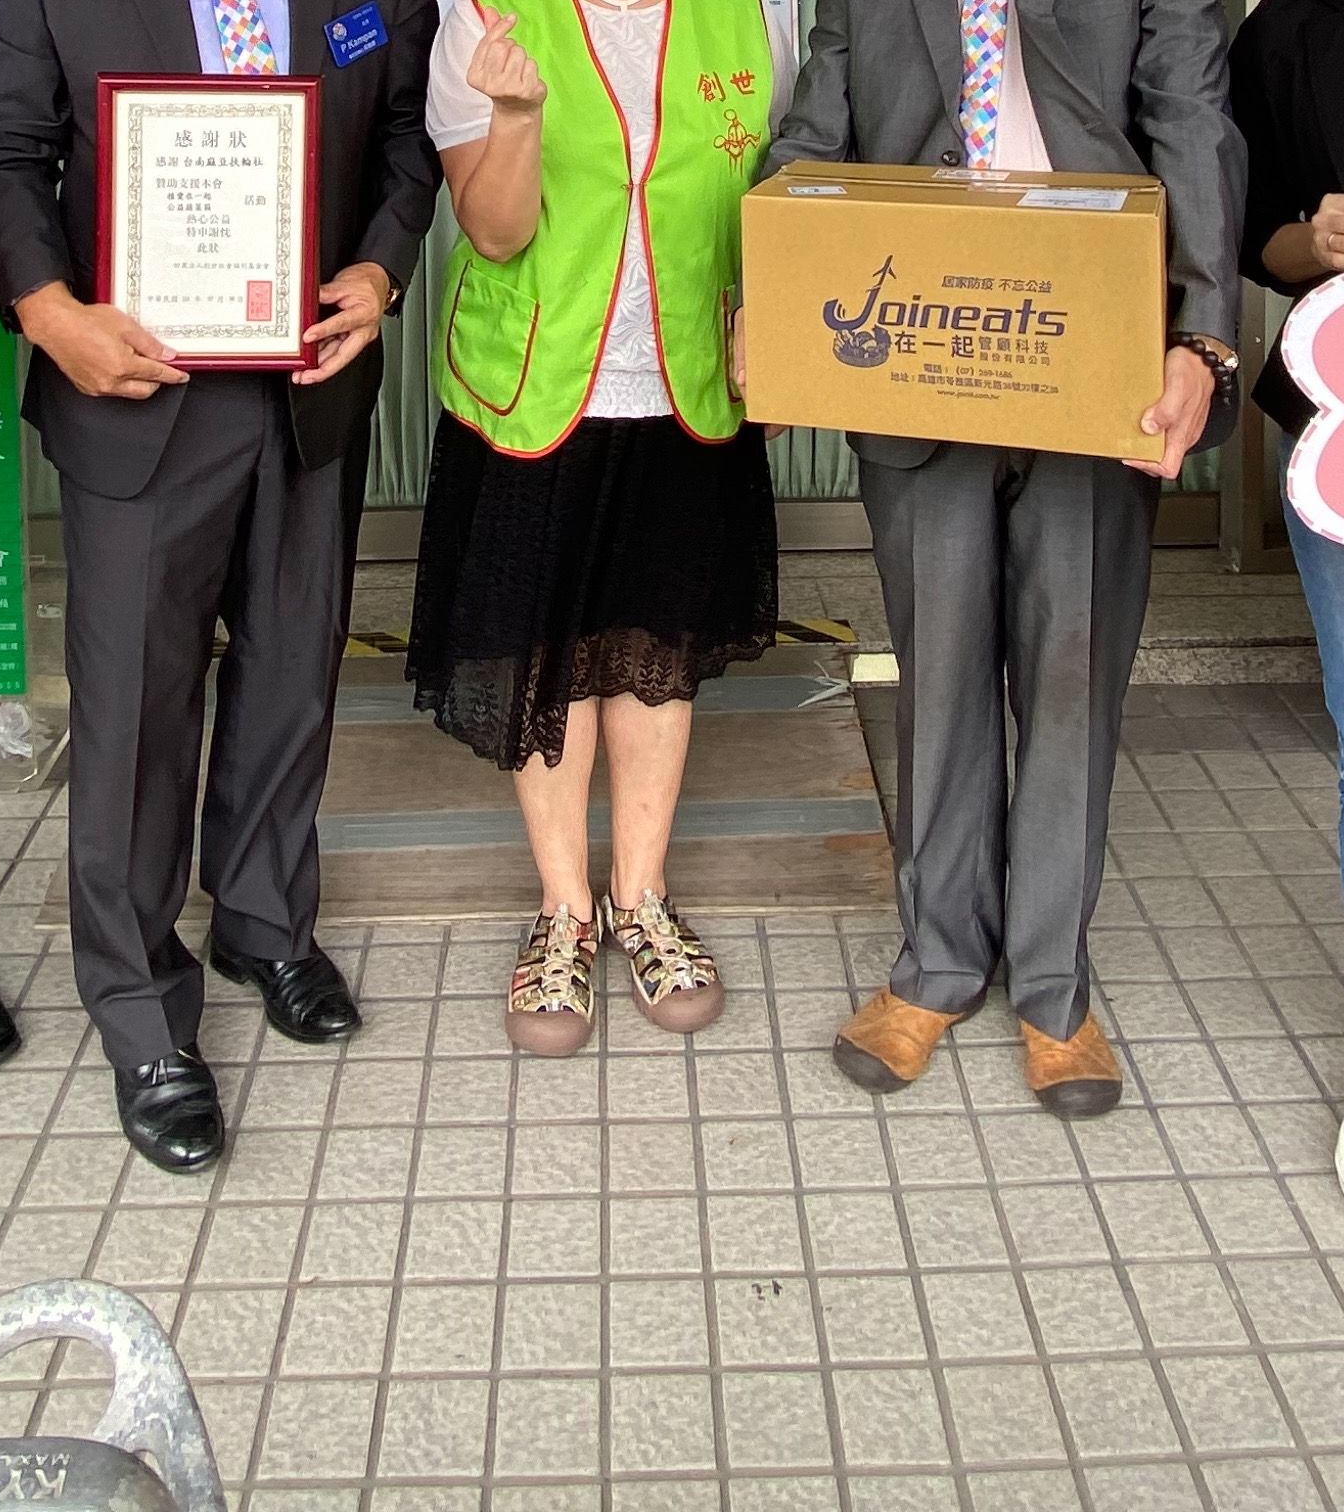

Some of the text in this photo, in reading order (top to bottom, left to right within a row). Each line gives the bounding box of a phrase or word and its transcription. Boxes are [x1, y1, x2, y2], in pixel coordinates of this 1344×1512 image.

[697, 68, 756, 103] 創世
[175, 129, 248, 149] 感謝狀
[822, 254, 1069, 337] Joineats
[998, 278, 1053, 294] 不忘公益
[894, 330, 976, 359] 在一起
